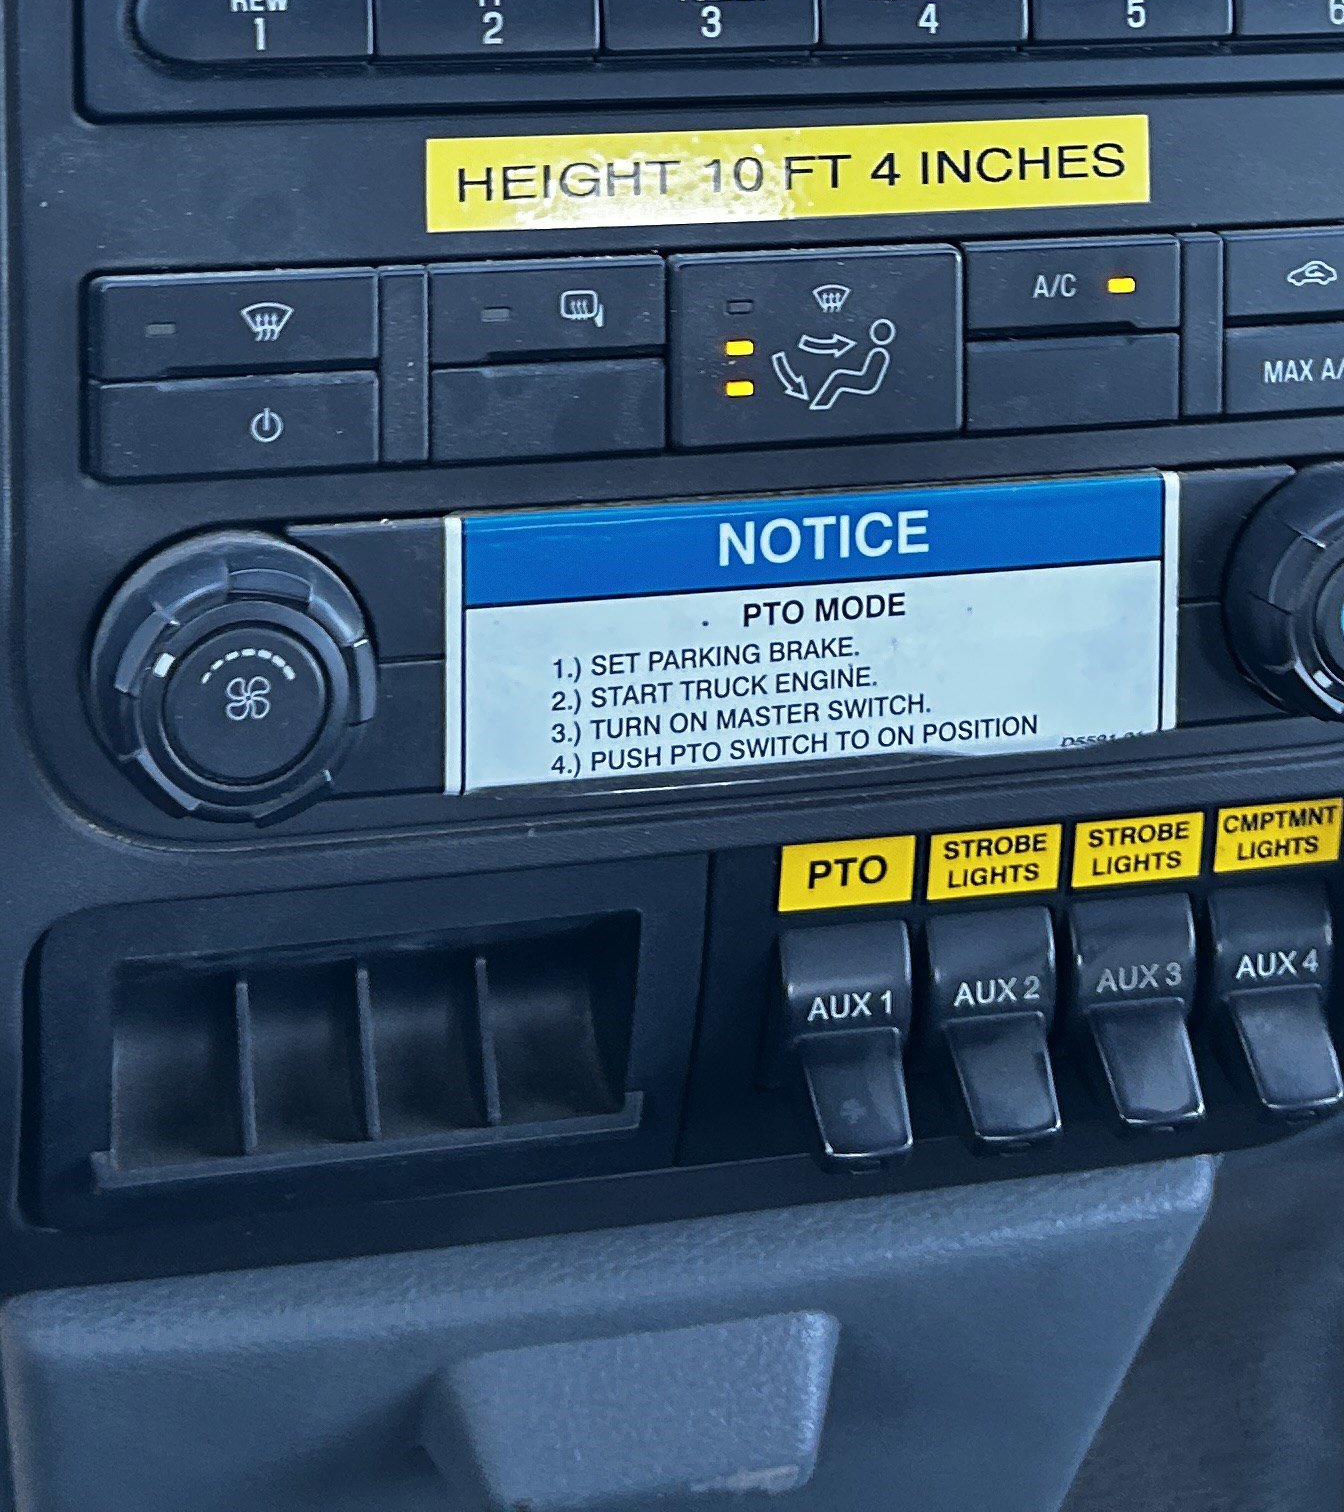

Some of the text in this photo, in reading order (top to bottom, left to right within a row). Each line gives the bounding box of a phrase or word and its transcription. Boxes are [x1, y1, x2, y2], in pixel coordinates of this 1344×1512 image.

[253, 17, 268, 52] 1
[482, 11, 504, 45] 2
[700, 6, 722, 39] 3
[918, 3, 939, 34] 4
[457, 142, 1127, 203] HEIGHT 10 FT 4 INCHES
[1033, 274, 1077, 299] A/C
[1264, 360, 1312, 384] MAX
[718, 509, 931, 568] NOTICE
[743, 592, 906, 627] PTO MODE
[552, 637, 860, 682] 1.) SET PARKING BRAKE.
[551, 666, 878, 715] 2.) START TRUCK ENGINE.
[551, 693, 932, 747] 3.) TURN ON MASTER SWITCH.
[551, 714, 1038, 779] 4.) PUSH PTO SWITCH TO ON POSITION
[1087, 820, 1190, 848] STROBE
[1222, 805, 1337, 836] CMPTMNT
[943, 833, 1048, 861] STROBE
[1092, 849, 1182, 877] LIGHTS
[1236, 834, 1319, 862] LIGHTS
[807, 855, 887, 890] PTO
[947, 862, 1040, 890] LIGHTS
[1096, 962, 1183, 994] AUX 3
[1235, 949, 1319, 980] AUX 4
[807, 990, 894, 1022] AUX 1
[953, 975, 1041, 1007] AUX 2
